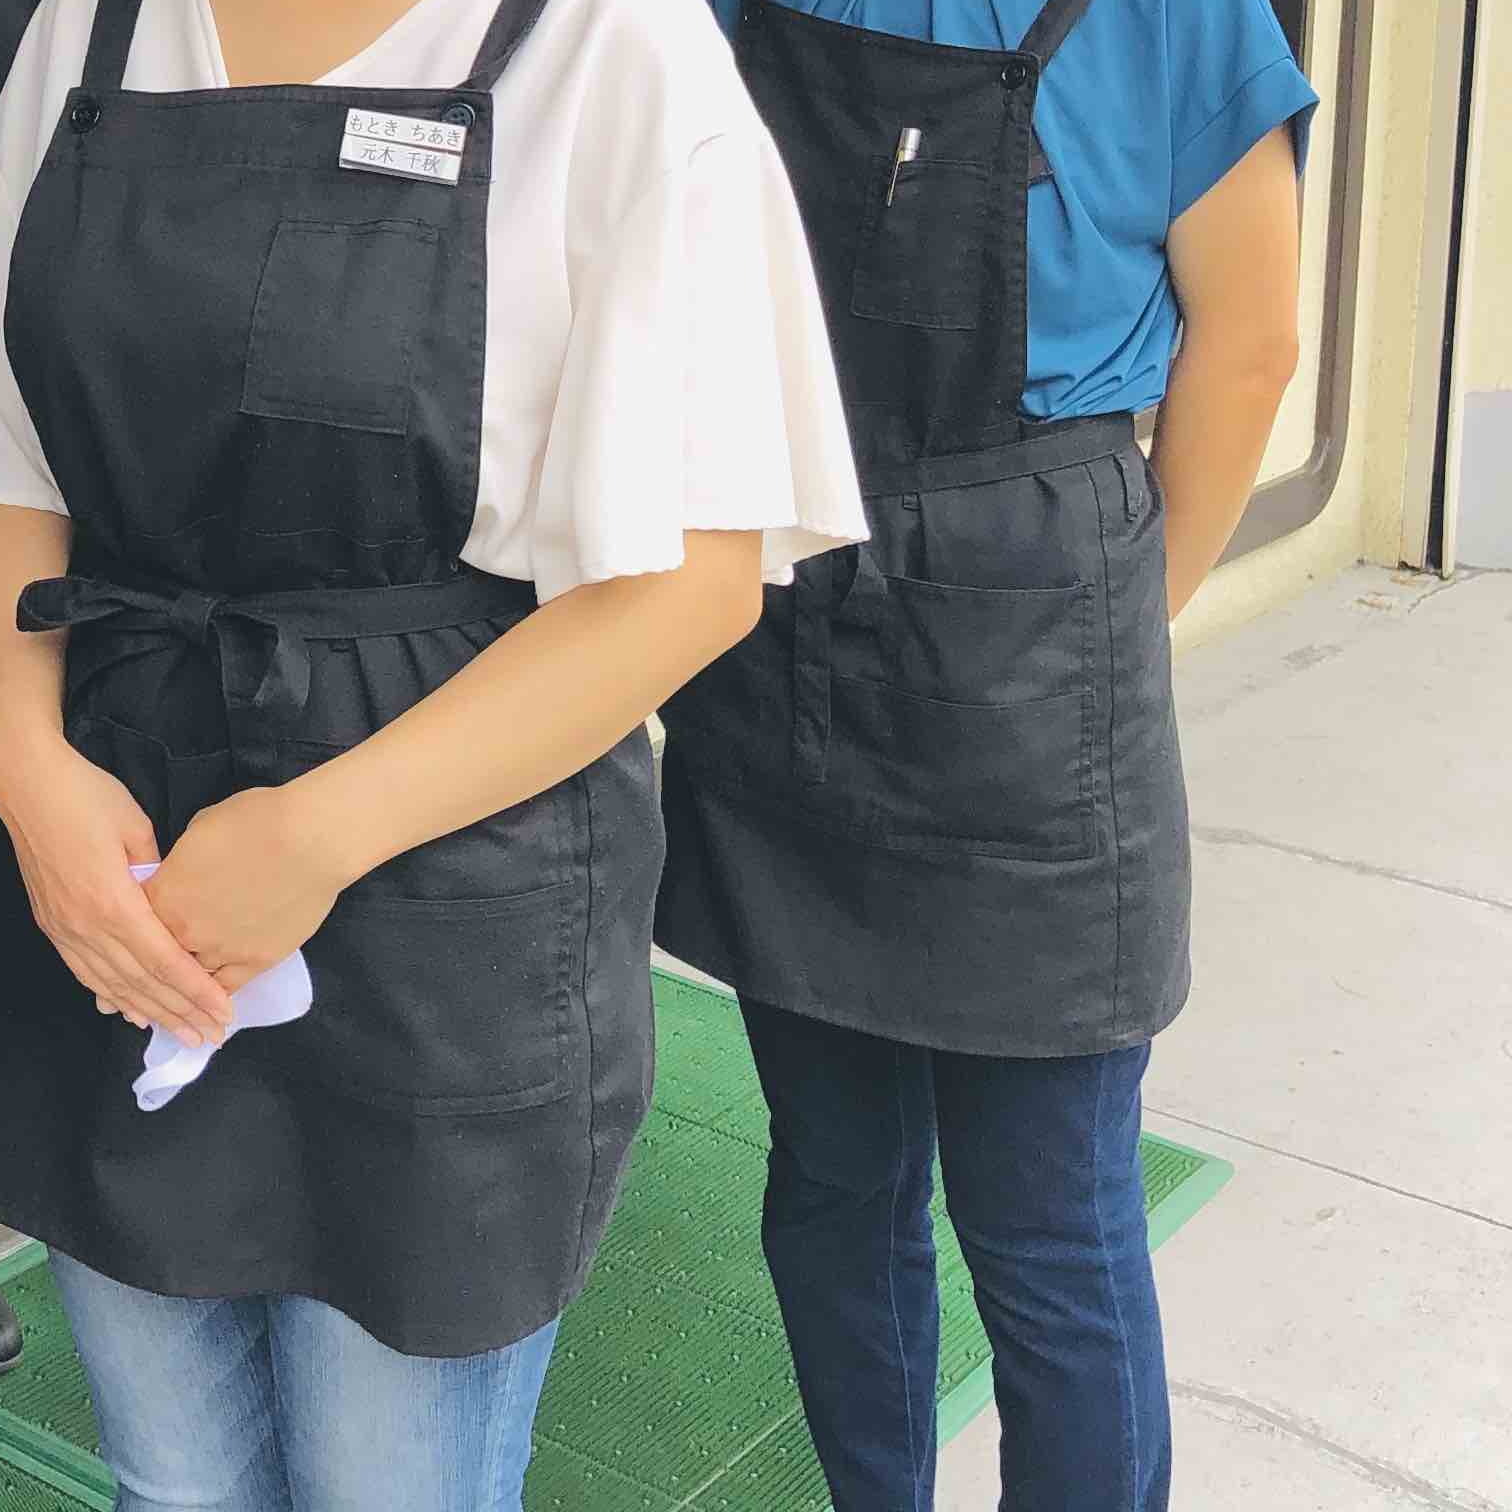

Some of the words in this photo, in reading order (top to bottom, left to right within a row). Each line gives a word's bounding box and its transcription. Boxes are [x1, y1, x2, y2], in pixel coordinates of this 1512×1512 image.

[349, 114, 399, 137] もとき
[412, 124, 461, 147] ちあき
[360, 143, 395, 164] 元木
[407, 151, 441, 174] 千秋
